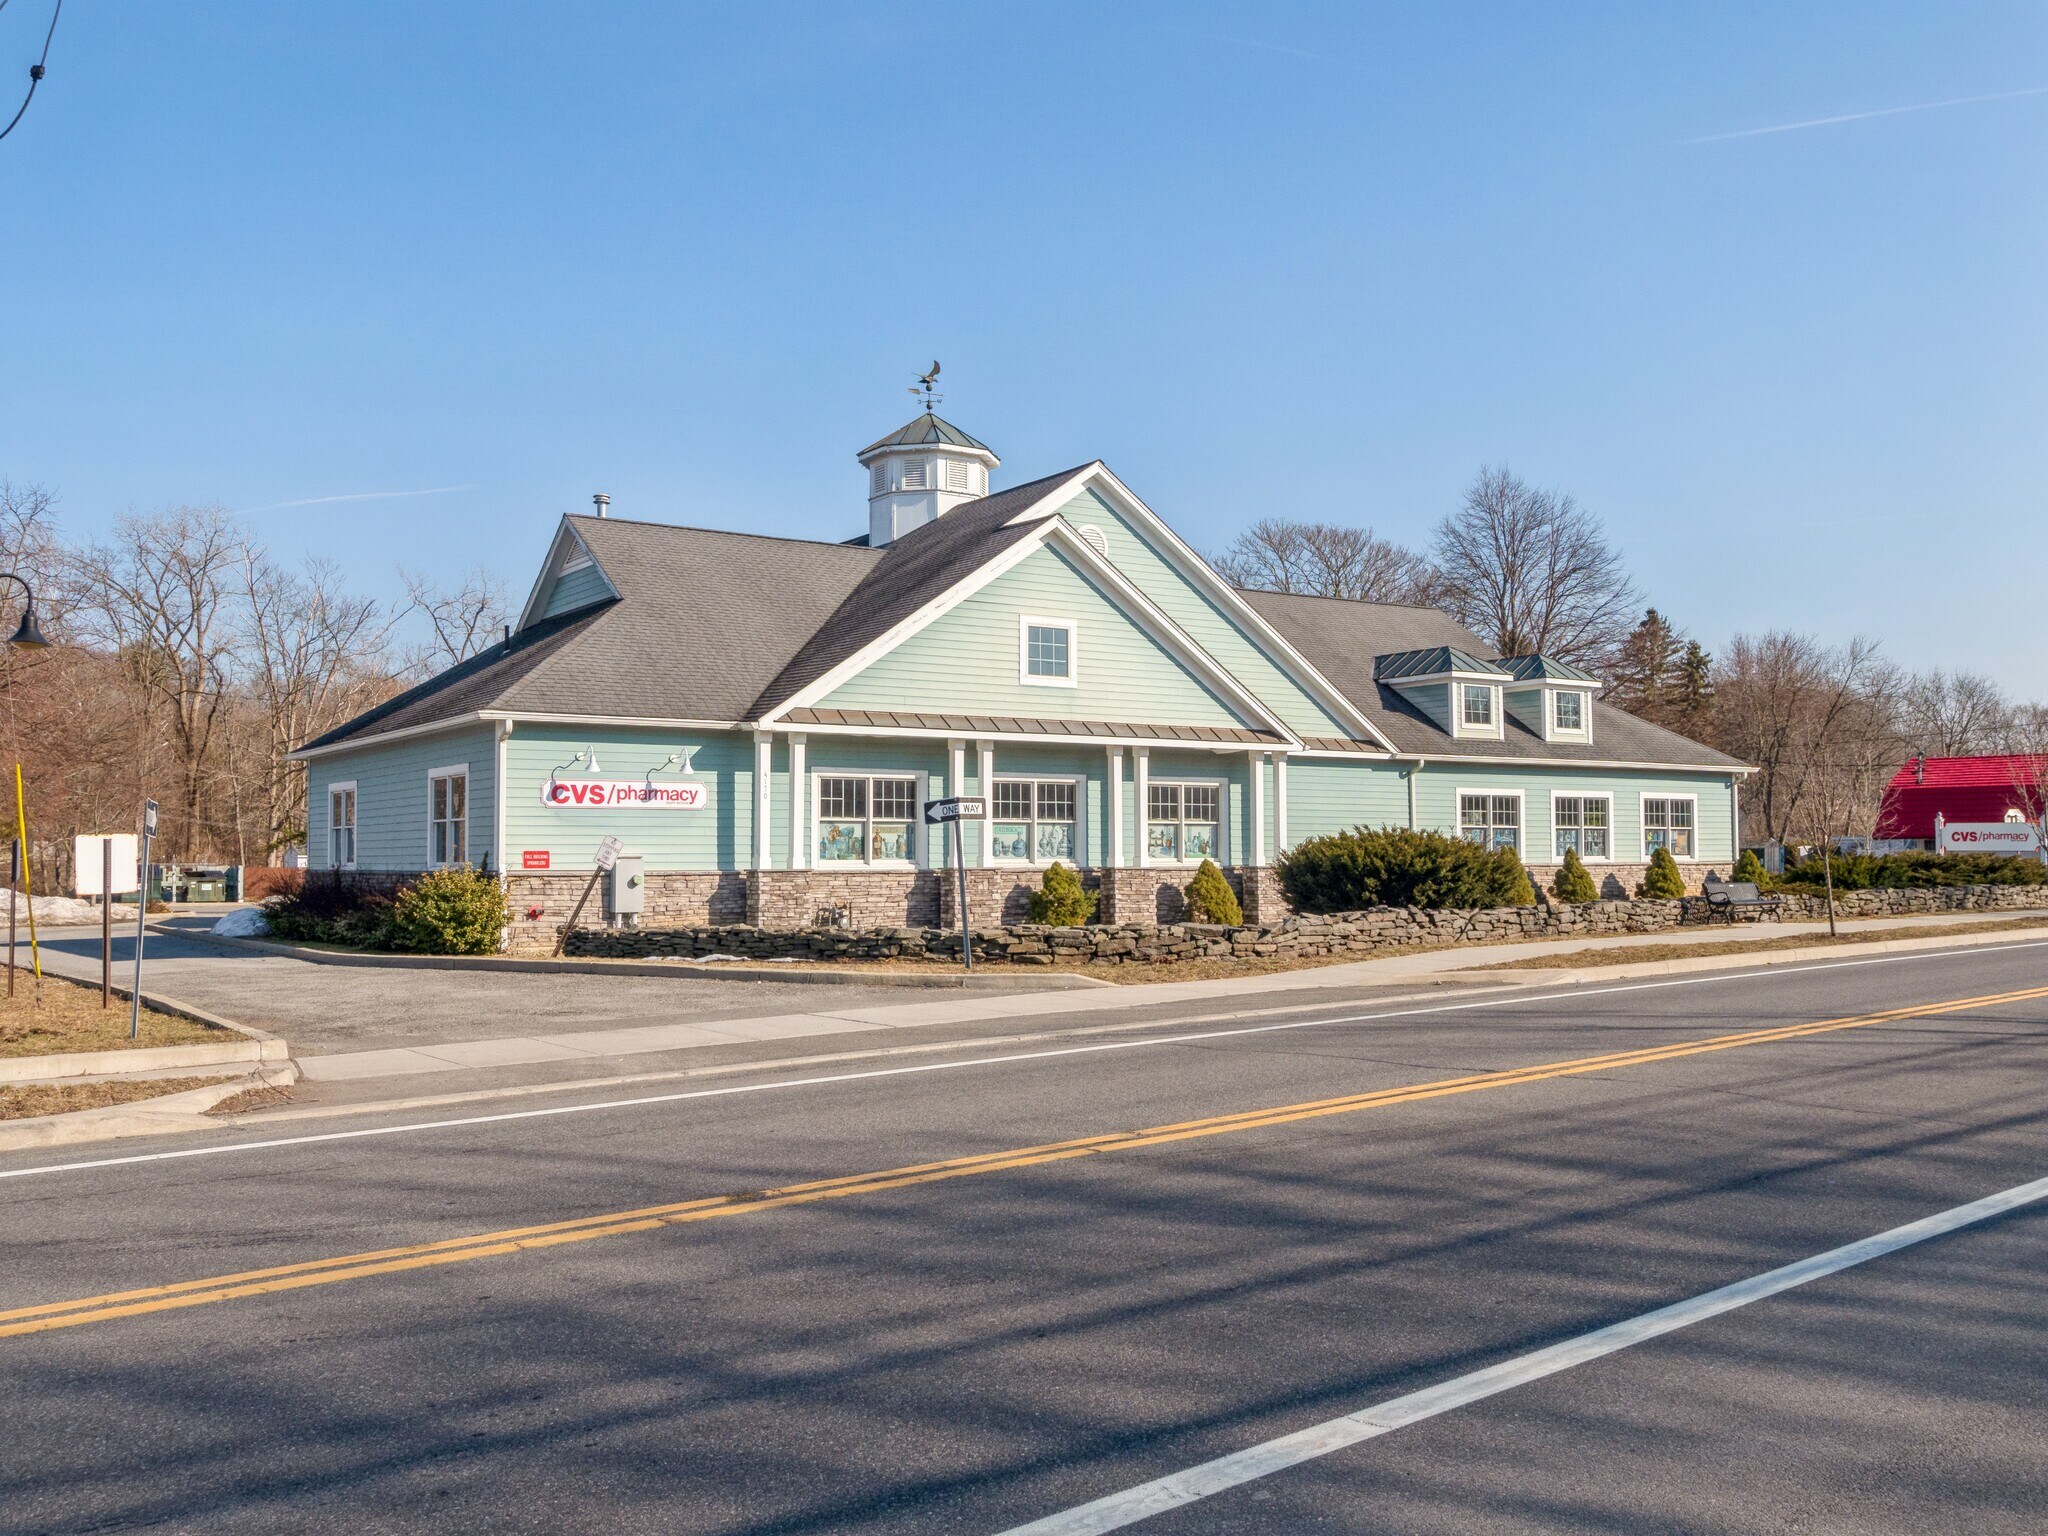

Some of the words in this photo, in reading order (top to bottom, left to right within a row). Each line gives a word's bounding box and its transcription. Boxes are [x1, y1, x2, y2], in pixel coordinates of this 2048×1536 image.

[551, 784, 698, 804] CVS/pharmacy
[942, 804, 959, 815] ONE
[963, 804, 980, 813] WAY
[1951, 831, 2029, 842] CVS/pharmacy
